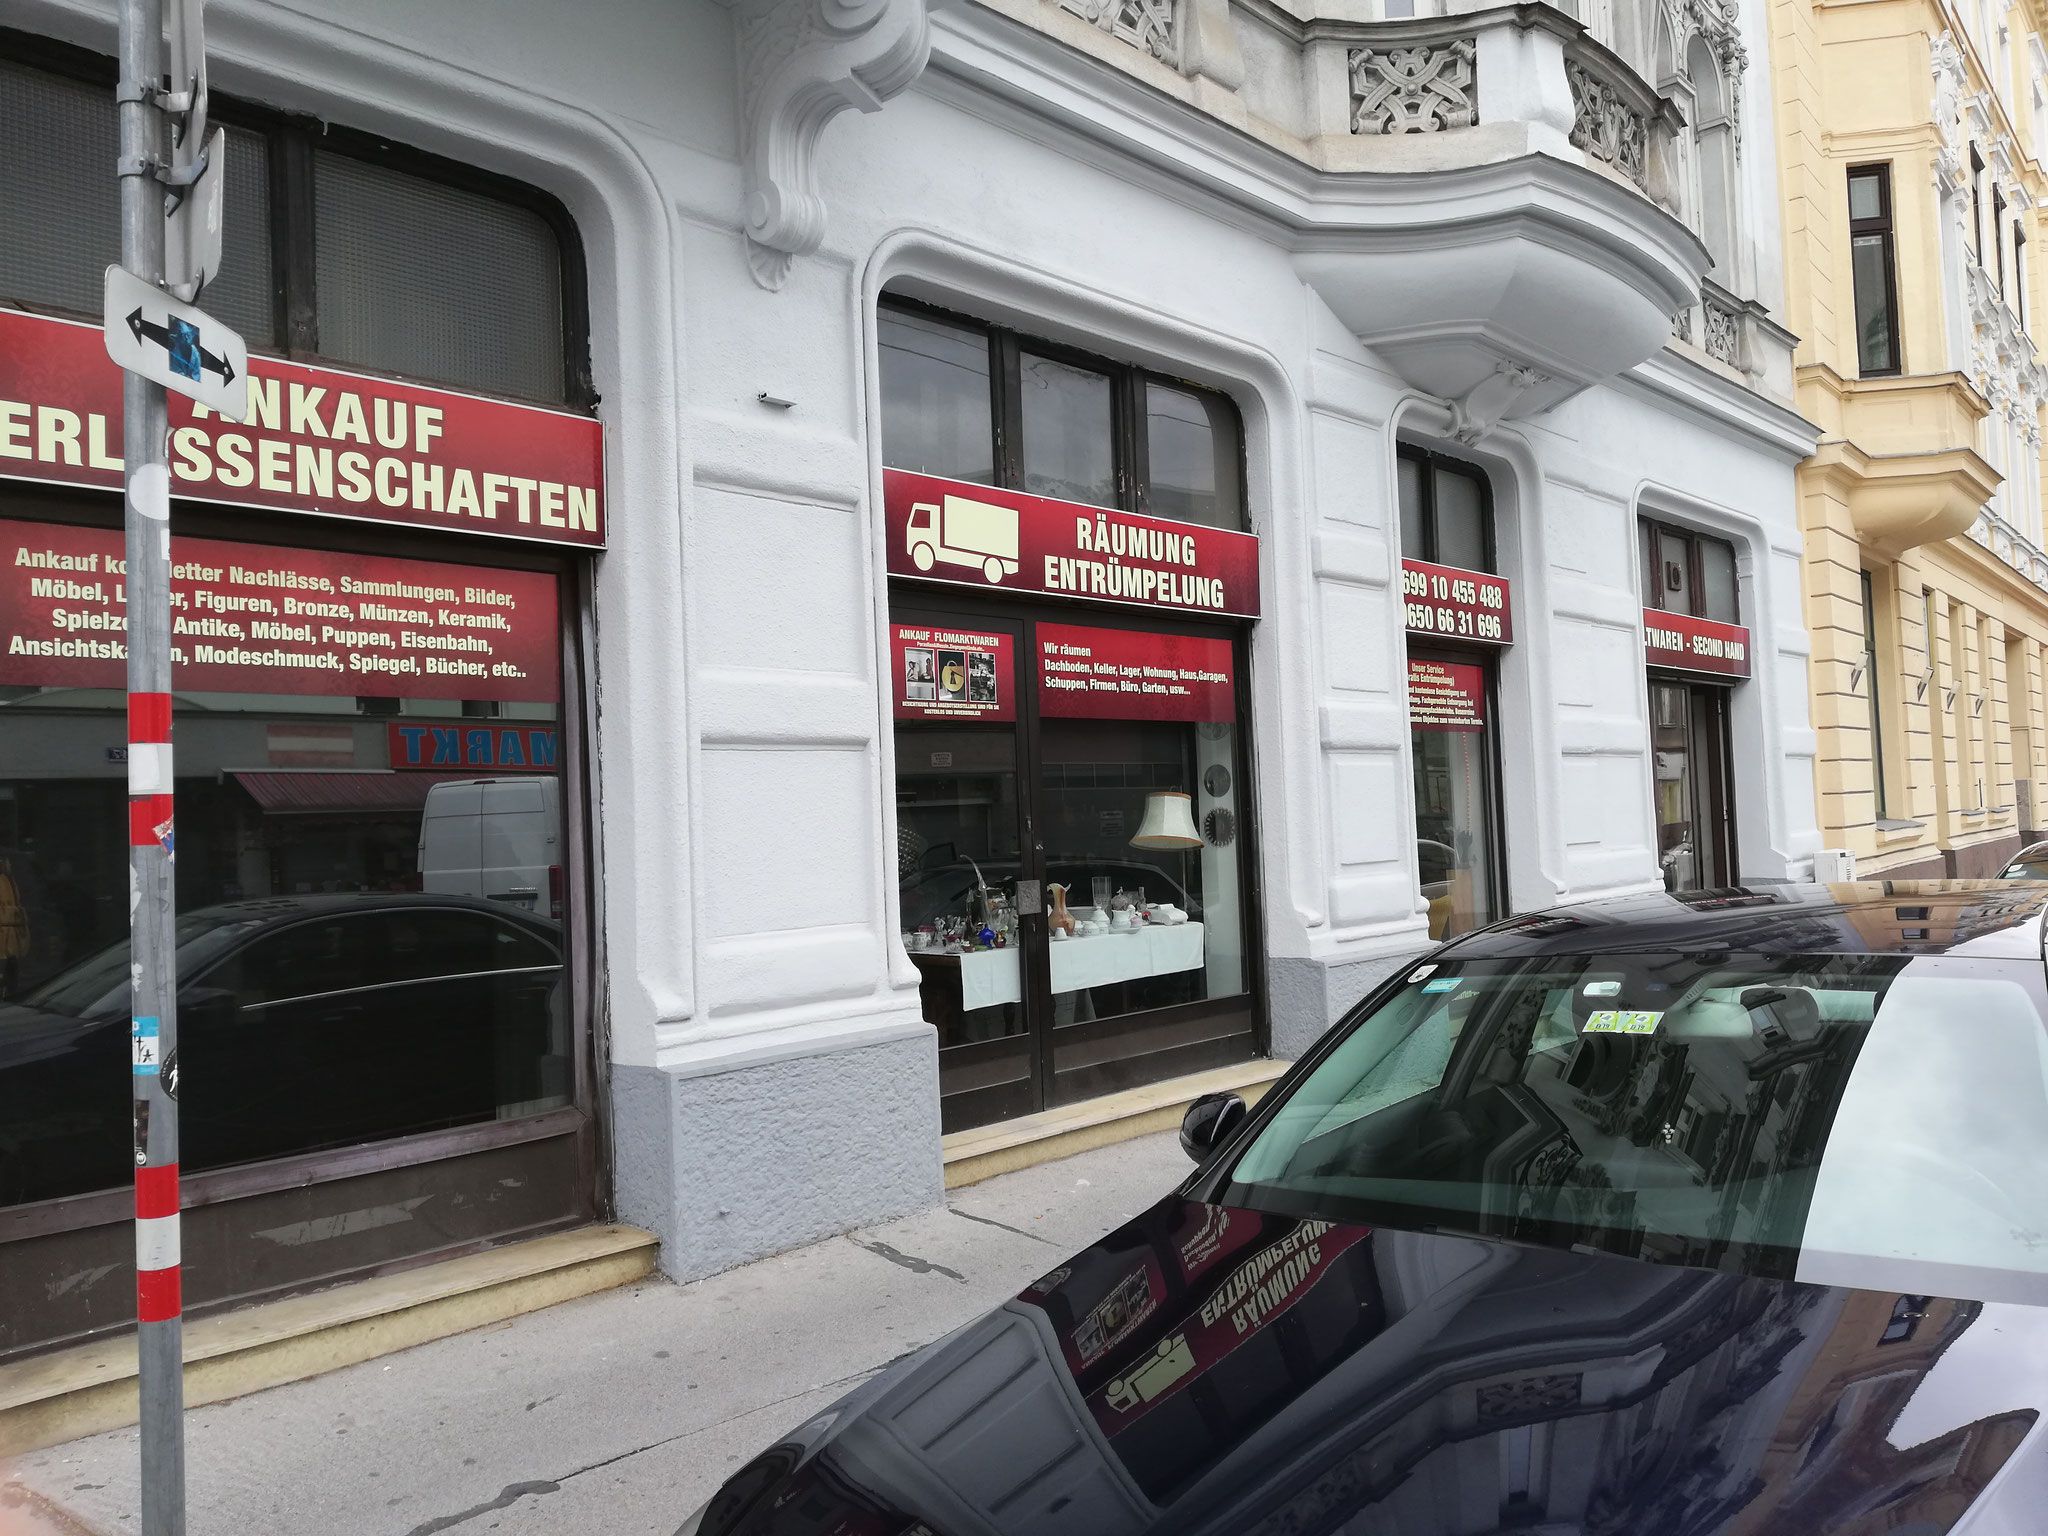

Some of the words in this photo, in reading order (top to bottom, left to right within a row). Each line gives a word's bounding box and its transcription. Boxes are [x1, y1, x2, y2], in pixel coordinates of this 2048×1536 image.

[0, 399, 597, 532] ERLSSENSCHAFTEN
[1076, 513, 1196, 566] RÄUMUNG
[15, 547, 98, 572] Ankauf
[230, 566, 335, 594] Nachlässe,
[340, 576, 460, 605] Sammlungen,
[464, 587, 516, 609] Bilder,
[1044, 555, 1224, 609] ENTRÜMPELUNG
[1431, 575, 1448, 600] 10
[1452, 579, 1476, 605] 455
[1480, 584, 1503, 609] 488
[31, 578, 109, 604] Möbel,
[195, 590, 278, 616] Figuren,
[284, 597, 354, 622] Bronze,
[359, 603, 434, 627] Münzen,
[438, 609, 511, 633] Keramik,
[1405, 602, 1434, 630] 650
[1437, 607, 1455, 632] 66
[1458, 611, 1473, 634] 31
[1478, 614, 1501, 638] 696
[173, 616, 245, 641] Antike,
[251, 621, 316, 645] Möbel,
[322, 626, 396, 649] Puppen,
[401, 631, 493, 655] Eisenbahn,
[899, 628, 930, 641] ANKAUF
[934, 632, 999, 646] FLOMARKTWAREN
[1043, 641, 1058, 655] Wir
[1060, 644, 1091, 657] räumen
[1644, 627, 1684, 651] TWAREN
[1693, 635, 1723, 658] SECOND
[1724, 641, 1745, 660] HAND
[195, 645, 344, 673] Modeschmuck,
[350, 653, 421, 676] Spiegel,
[426, 657, 488, 679] Bücher,
[492, 662, 527, 678] etc..
[1044, 659, 1093, 675] Dachboden,
[1093, 662, 1119, 678] Keller,
[1119, 664, 1142, 679] Lager,
[1143, 666, 1179, 681] Wohnung,
[1427, 664, 1444, 674] Service
[1045, 676, 1089, 692] Schuppen,
[1089, 679, 1120, 693] Firmen,
[1120, 680, 1141, 695] Büro,
[1142, 682, 1169, 696] Garten,
